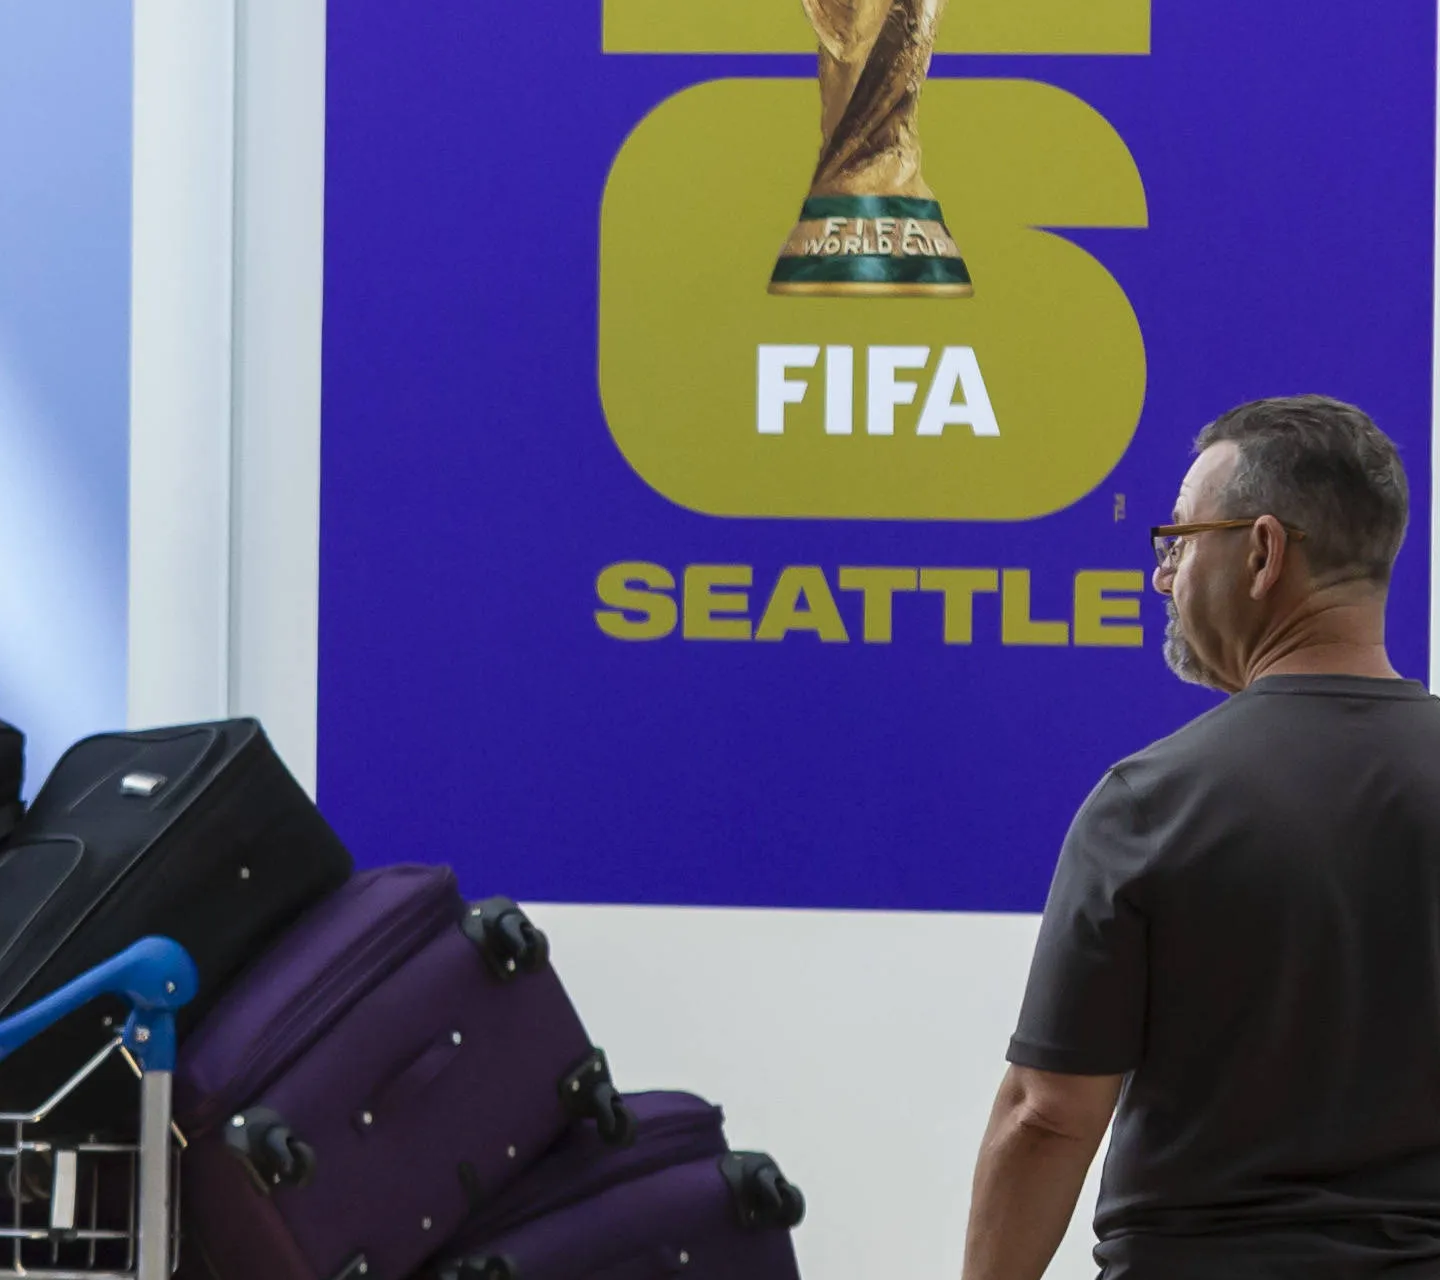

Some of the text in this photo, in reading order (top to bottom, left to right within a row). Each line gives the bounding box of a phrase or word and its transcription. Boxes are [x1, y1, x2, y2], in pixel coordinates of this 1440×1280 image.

[804, 235, 948, 256] WORLD CUP
[824, 216, 925, 237] FIFA
[756, 344, 1000, 437] FIFA
[595, 561, 1144, 648] SEATTLE
